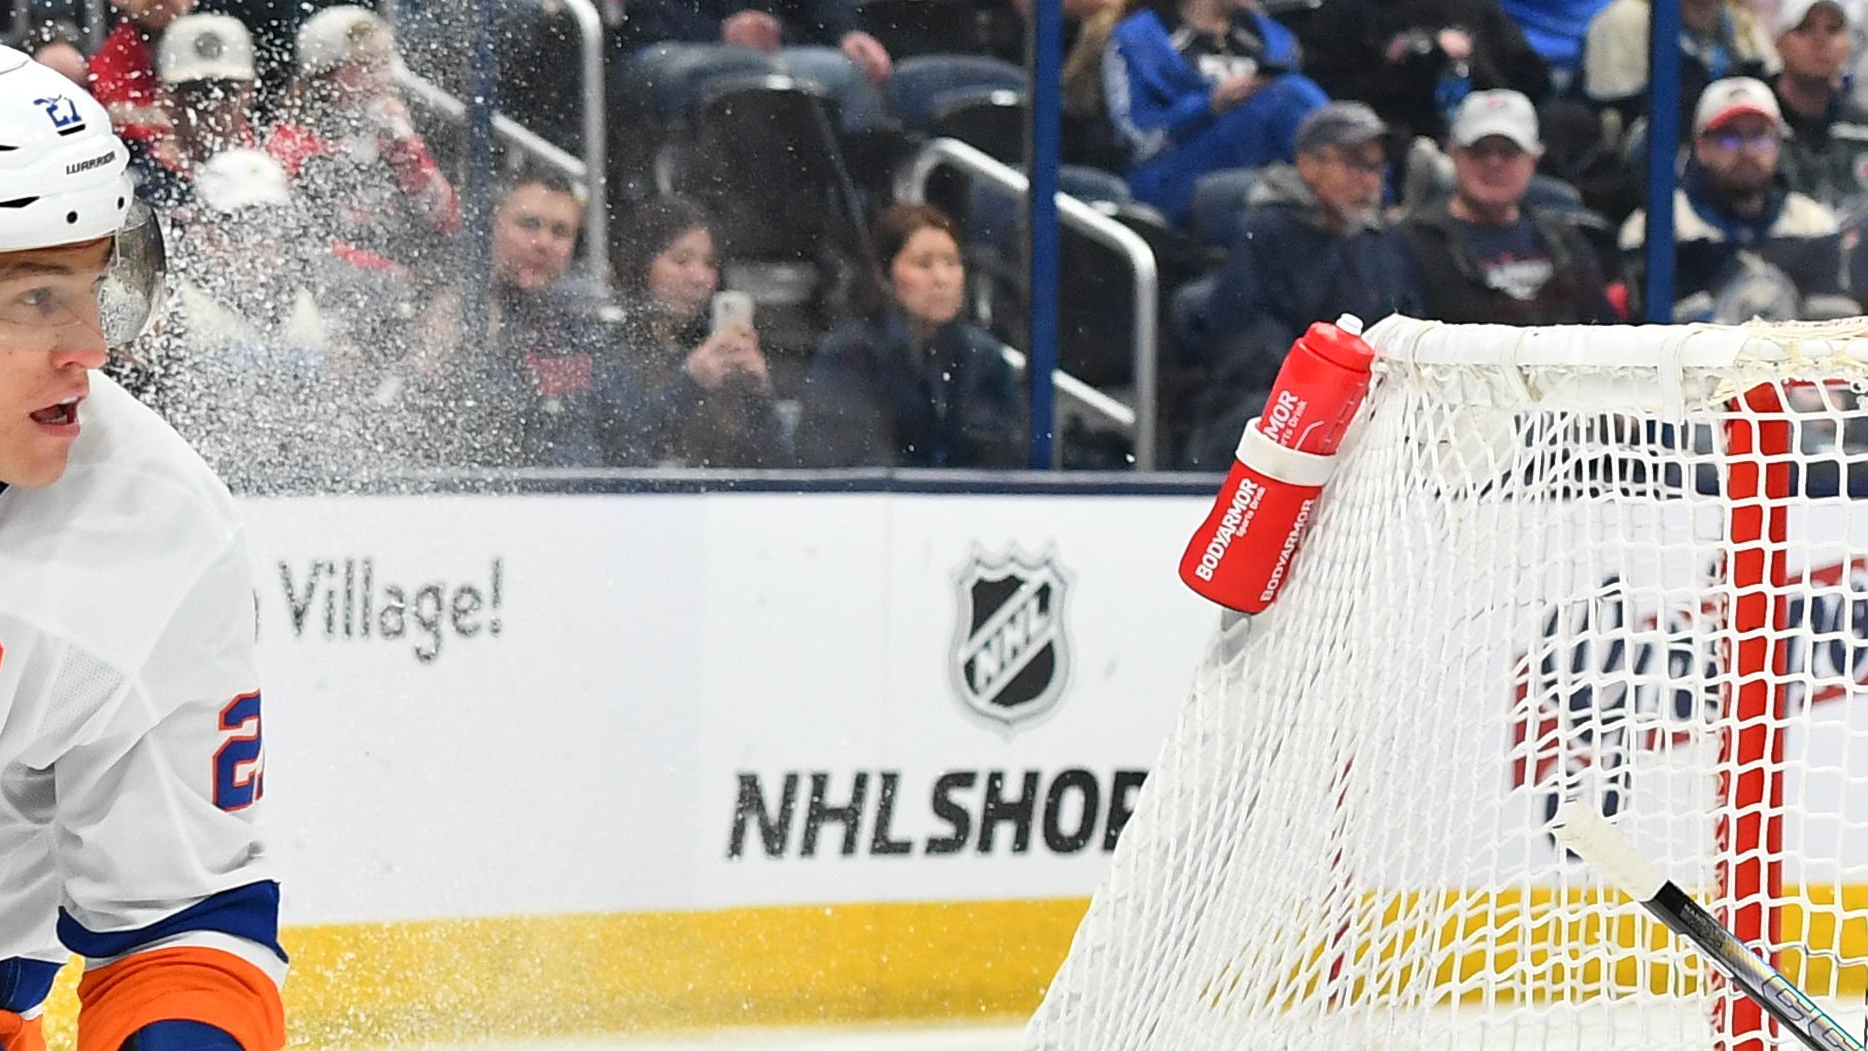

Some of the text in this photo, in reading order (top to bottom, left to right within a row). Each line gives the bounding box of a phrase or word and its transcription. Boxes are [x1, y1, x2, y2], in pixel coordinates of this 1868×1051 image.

[1195, 478, 1259, 582] BODYARMOR
[1259, 499, 1314, 602] BODYARMOR
[278, 557, 502, 663] Village!
[211, 688, 264, 813] 2
